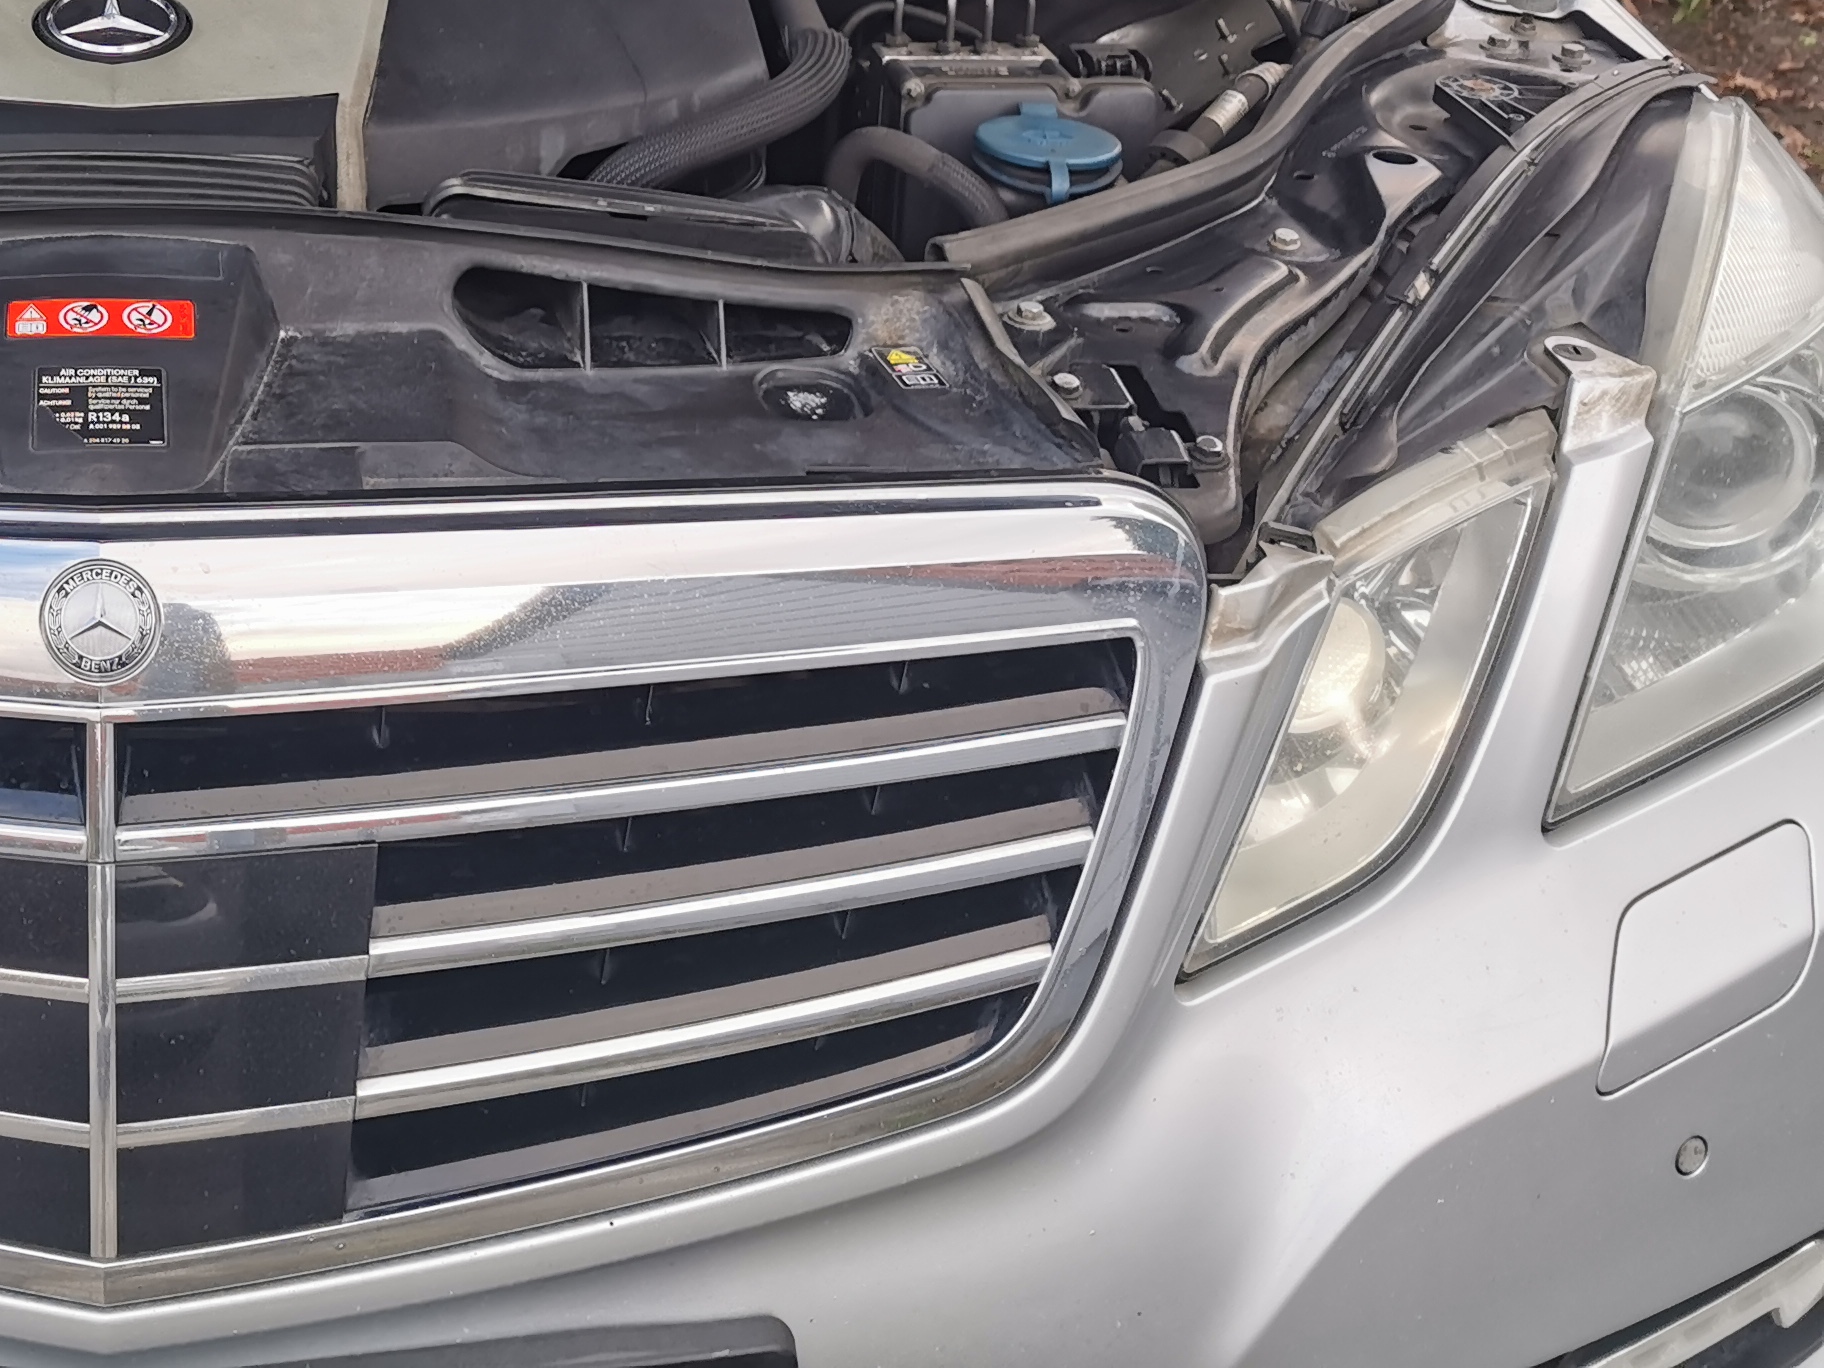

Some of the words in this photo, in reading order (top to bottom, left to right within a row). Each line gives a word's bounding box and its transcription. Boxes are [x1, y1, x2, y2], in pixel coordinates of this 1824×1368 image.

[59, 368, 75, 376] AIR
[77, 368, 140, 376] CONDITIONER
[41, 375, 107, 384] KLIMAANLAGE
[108, 375, 129, 384] (SAE
[136, 376, 158, 385] 639)
[87, 411, 130, 422] R134a
[62, 568, 138, 593] MERCEDES
[80, 657, 121, 673] BENZ
